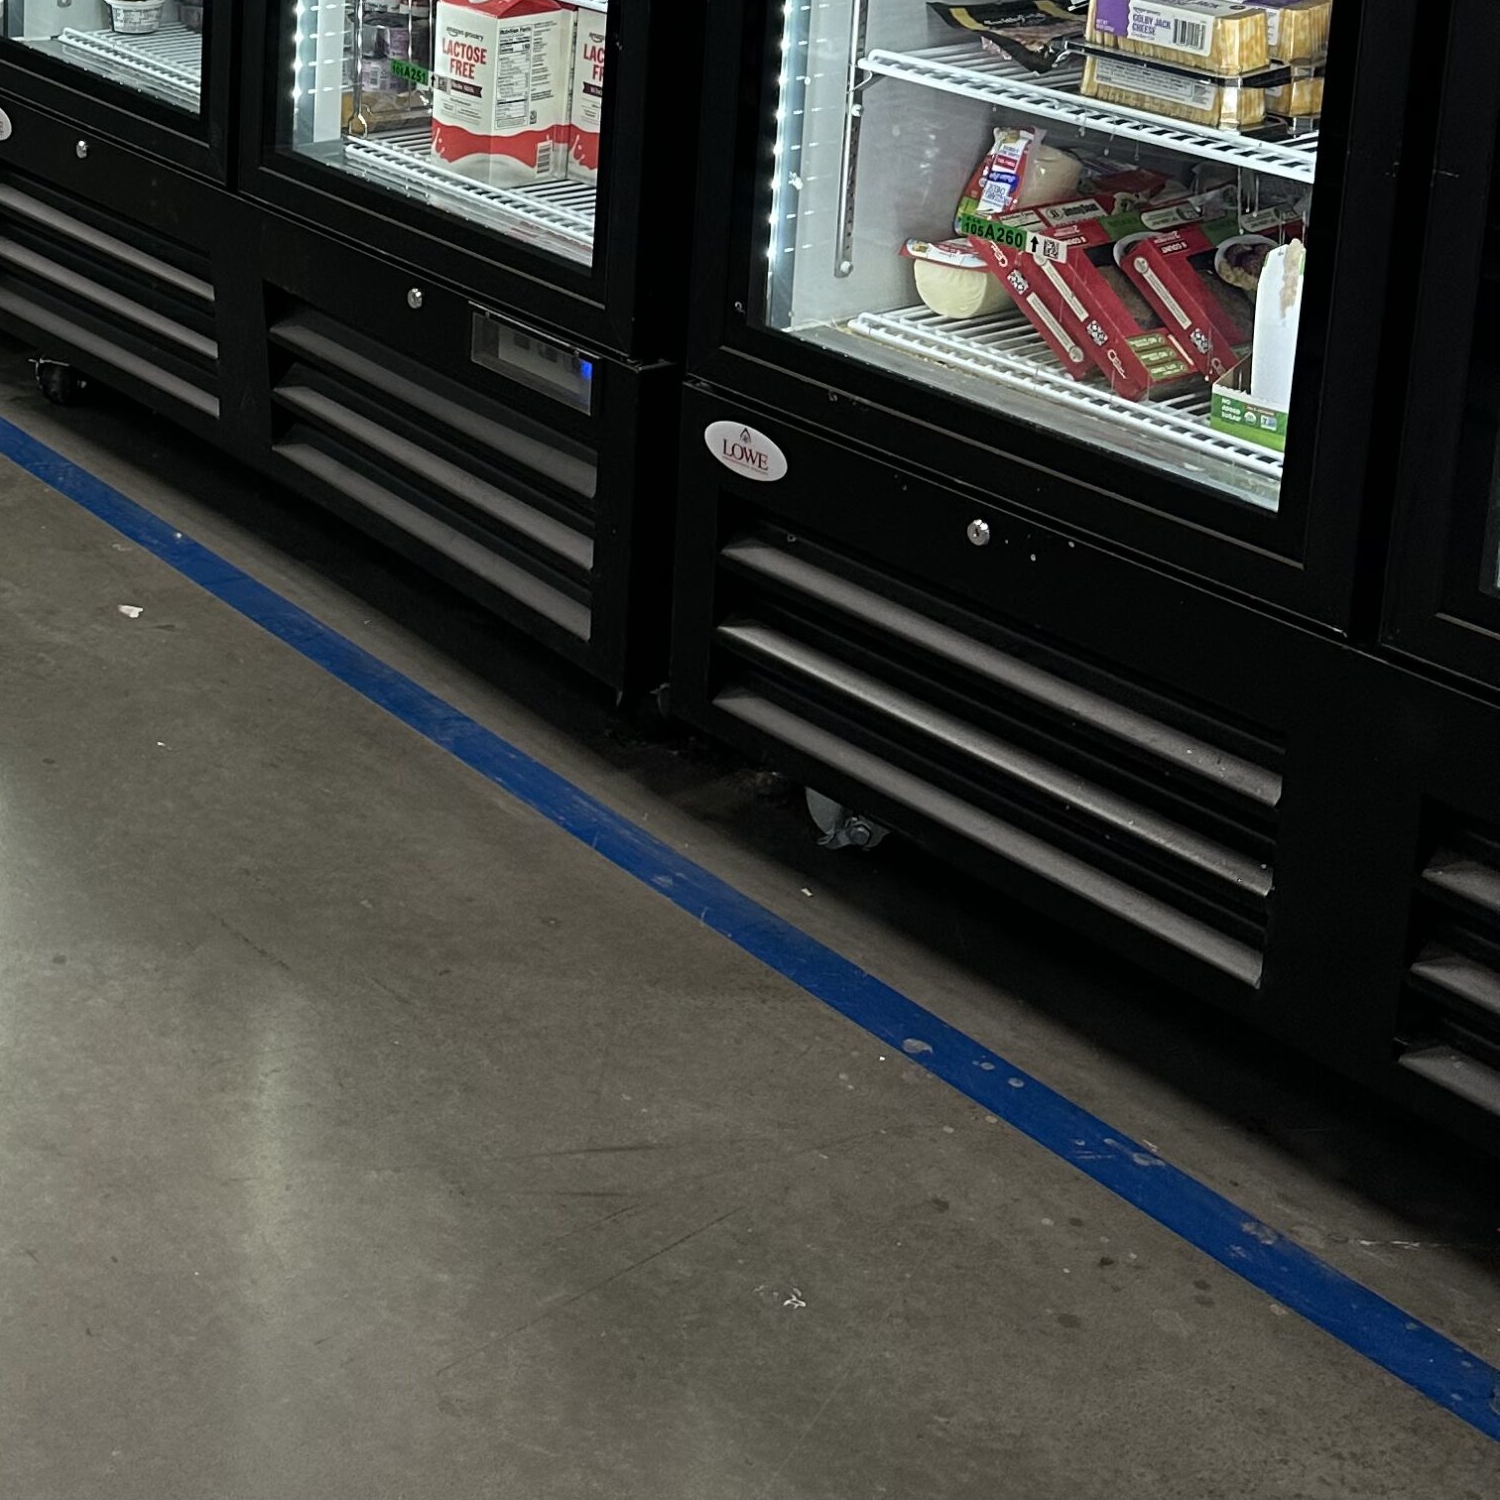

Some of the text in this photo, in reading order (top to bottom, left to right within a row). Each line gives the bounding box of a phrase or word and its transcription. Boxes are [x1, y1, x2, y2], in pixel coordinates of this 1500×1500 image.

[1132, 22, 1156, 36] CHEESE
[1133, 14, 1171, 30] COLBY JACK
[446, 26, 484, 42] amazon grocery
[442, 37, 487, 65] LACTOSE
[450, 57, 475, 80] FREE
[964, 222, 1023, 248] 105A260
[723, 439, 768, 471] LOWE
